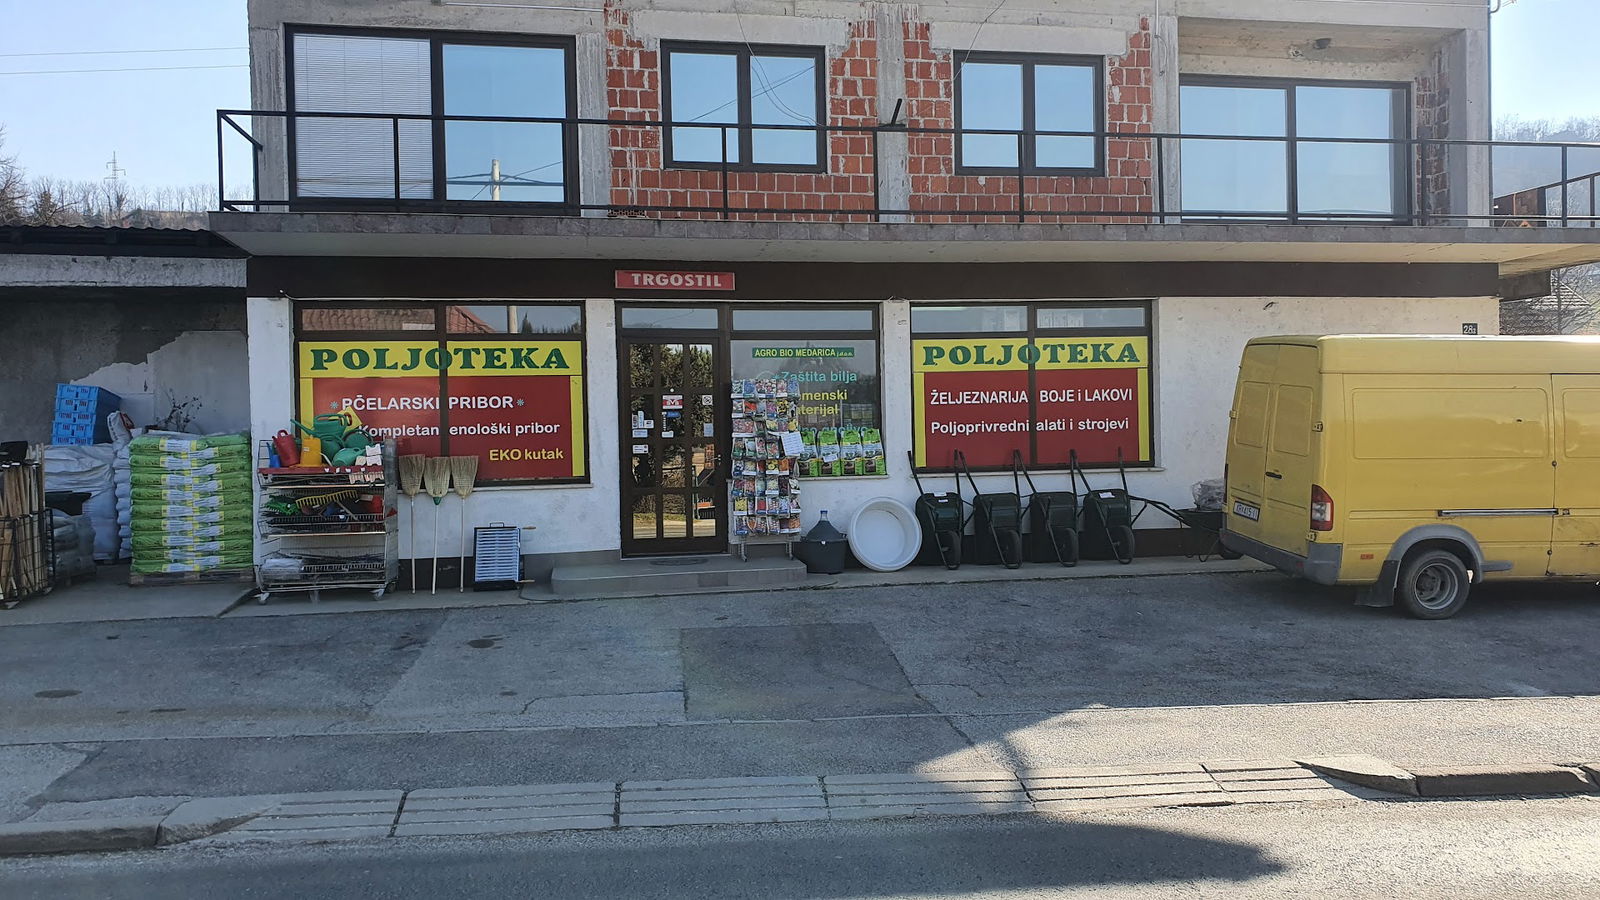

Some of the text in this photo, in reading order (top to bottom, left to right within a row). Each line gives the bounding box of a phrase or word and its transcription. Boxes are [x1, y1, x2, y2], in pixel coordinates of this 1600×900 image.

[631, 273, 722, 287] TRGOSTIL
[310, 347, 570, 371] POLJOTEKA
[754, 348, 777, 357] AGRO
[779, 348, 794, 357] BIO
[795, 348, 836, 357] MEDARICA
[922, 342, 1141, 366] POLJOTEKA
[781, 369, 858, 384] Zaštita bilja
[341, 394, 514, 411] PČELARSKI PRIBOR
[799, 389, 849, 401] menski
[930, 388, 1133, 405] ŽELJEZNARIJA BOJE i LAKOVI
[449, 422, 511, 435] enološki
[515, 421, 561, 437] pribor
[931, 417, 1129, 436] Poljoprivredni alati i strojevi
[489, 447, 564, 461] EKO kutak
